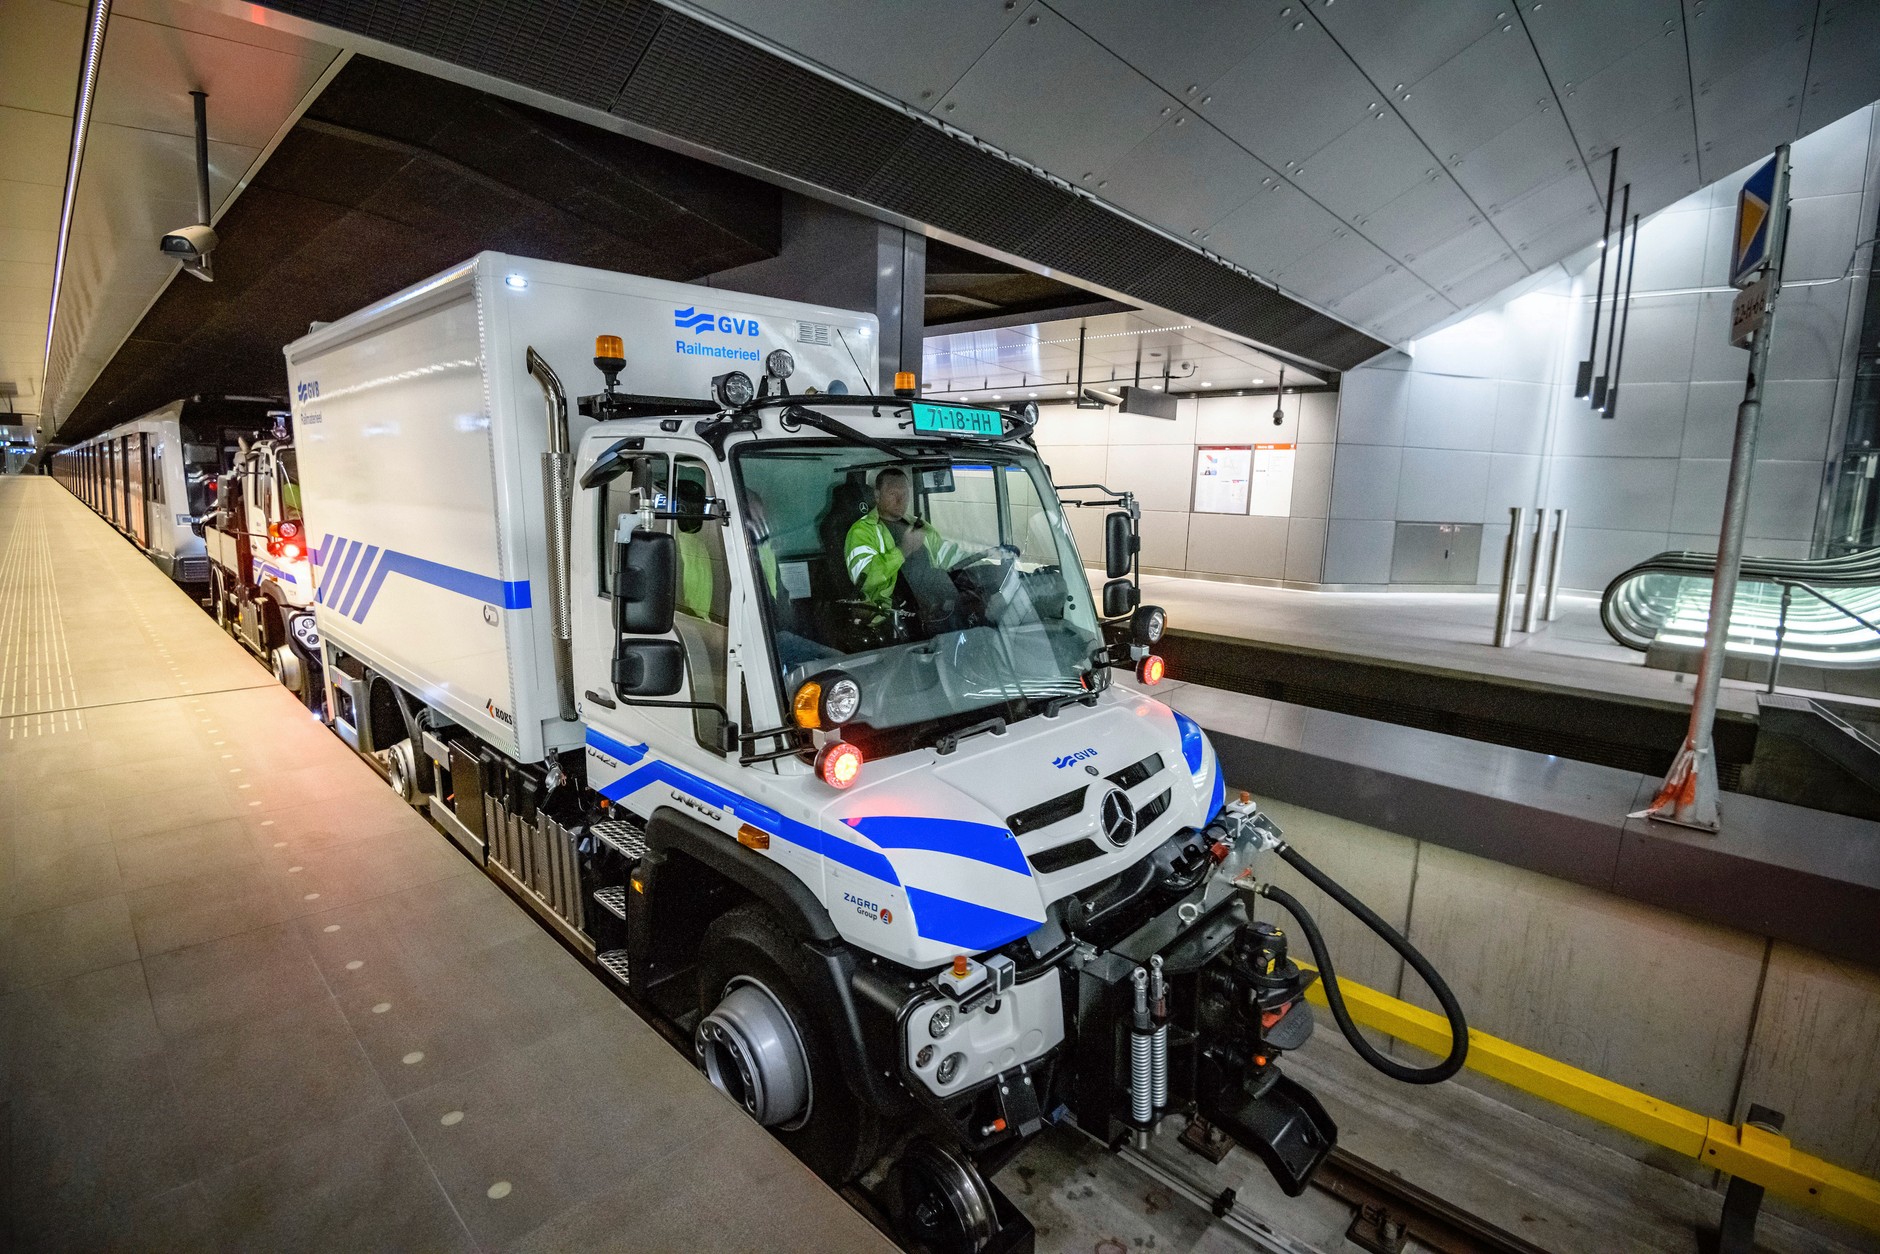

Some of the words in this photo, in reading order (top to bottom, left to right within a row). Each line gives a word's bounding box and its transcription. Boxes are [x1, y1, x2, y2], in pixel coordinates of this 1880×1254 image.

[718, 316, 759, 337] GVB
[676, 340, 760, 361] Railmaterieel
[307, 381, 319, 399] GVB
[927, 408, 992, 432] 71-18-HH
[495, 707, 513, 725] KOKS
[1073, 748, 1098, 760] GVB
[671, 790, 721, 821] UNIMOG
[844, 892, 878, 912] ZAGRO
[857, 907, 878, 921] Group
